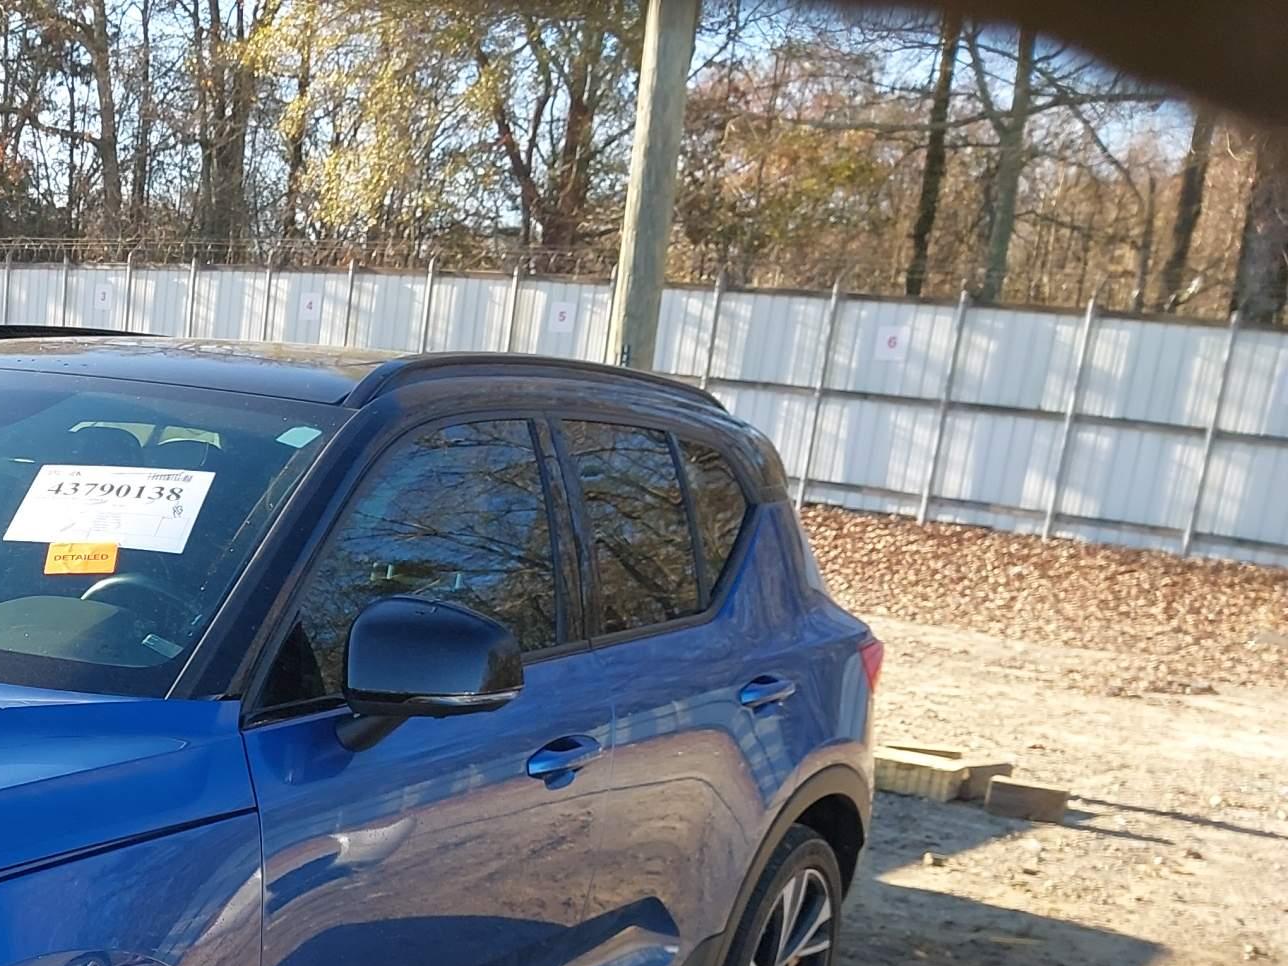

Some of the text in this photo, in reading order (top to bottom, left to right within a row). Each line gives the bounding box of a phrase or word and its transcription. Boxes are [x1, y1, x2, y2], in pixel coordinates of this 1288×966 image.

[559, 311, 567, 322] 5
[887, 336, 897, 349] 6
[47, 481, 184, 501] 43790138
[53, 553, 109, 561] DETAILED
